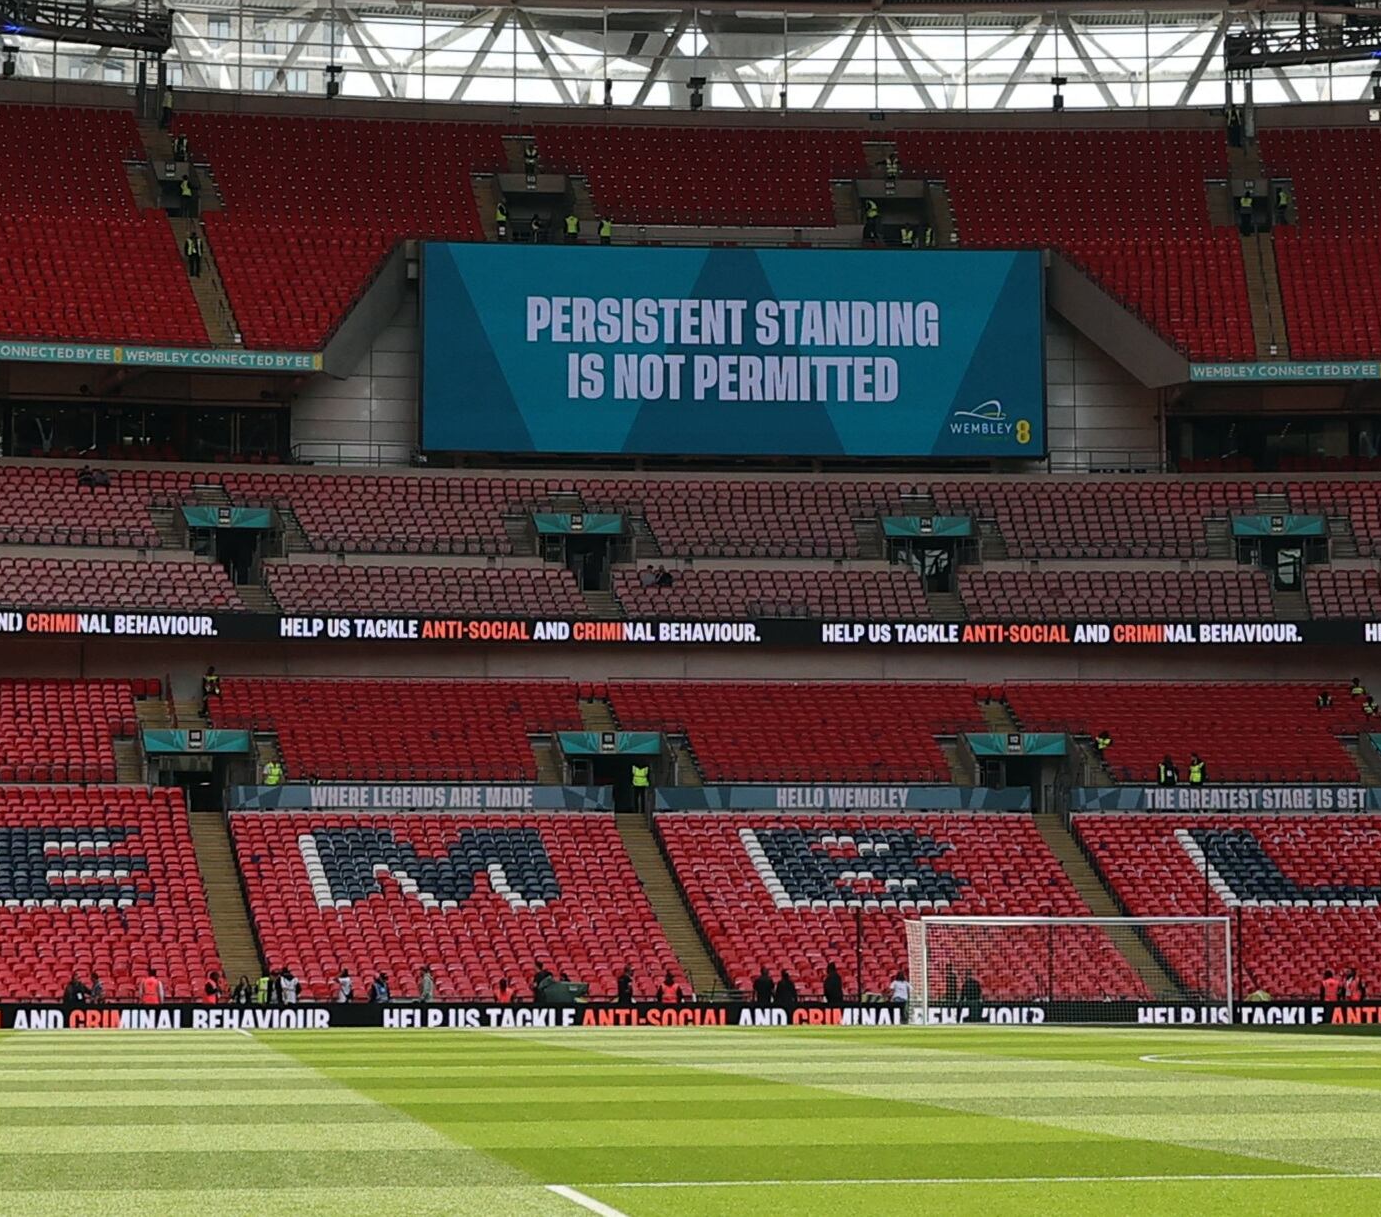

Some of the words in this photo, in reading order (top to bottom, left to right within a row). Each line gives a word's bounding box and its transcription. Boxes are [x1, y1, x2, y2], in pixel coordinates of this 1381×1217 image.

[526, 296, 747, 344] PERSISTENT
[756, 301, 938, 346] STANDING
[569, 353, 604, 398] IS
[615, 354, 685, 399] NOT
[694, 356, 898, 401] PERMITTED
[1193, 366, 1254, 377] WEMBLEY
[1259, 365, 1340, 376] CONNECTED
[1343, 366, 1359, 375] BY
[1362, 365, 1376, 375] EE
[950, 423, 1012, 434] WEMBLEY
[27, 613, 110, 634] CRIMINAL
[115, 615, 217, 635] BEHAVIOUR.
[281, 618, 323, 636] HELP
[328, 618, 350, 637] US
[354, 620, 418, 638] TACKLE
[422, 620, 529, 640] ANTI-SOCIAL
[534, 622, 569, 639] AND
[573, 622, 655, 641] CRIMINAL
[660, 623, 760, 642] BEHAVIOUR.
[823, 624, 864, 642] HELP
[869, 624, 891, 642] US
[895, 625, 958, 642] TACKLE
[963, 625, 1069, 642] ANTI-SOCIAL
[1074, 625, 1109, 642] AND
[1114, 624, 1196, 643] CRIMINAL
[1200, 624, 1302, 642] BEHAVIOUR.
[310, 787, 369, 807] WHERE
[373, 787, 446, 807] LEGENDS
[449, 787, 482, 807] ARE
[486, 787, 533, 807] MADE
[776, 788, 824, 807] HELLO
[829, 788, 908, 807] WEMBLEY
[1145, 788, 1175, 809] THE
[1179, 788, 1259, 809] GREATEST
[1262, 788, 1313, 809] STAGE
[1316, 788, 1332, 809] IS
[1337, 788, 1367, 809] SET
[14, 1010, 63, 1029] AND
[70, 1010, 180, 1029] CRIMINAL
[384, 1009, 443, 1028] HELP
[449, 1009, 480, 1028] US
[486, 1009, 575, 1027] TACKLE
[583, 1008, 725, 1026] ANTI-SOCIAL
[739, 1009, 787, 1025] AND
[793, 1008, 901, 1025] CRIMINAL
[1138, 1008, 1195, 1024] HELP
[1201, 1007, 1228, 1023] US
[1238, 1007, 1324, 1024] TACKLE
